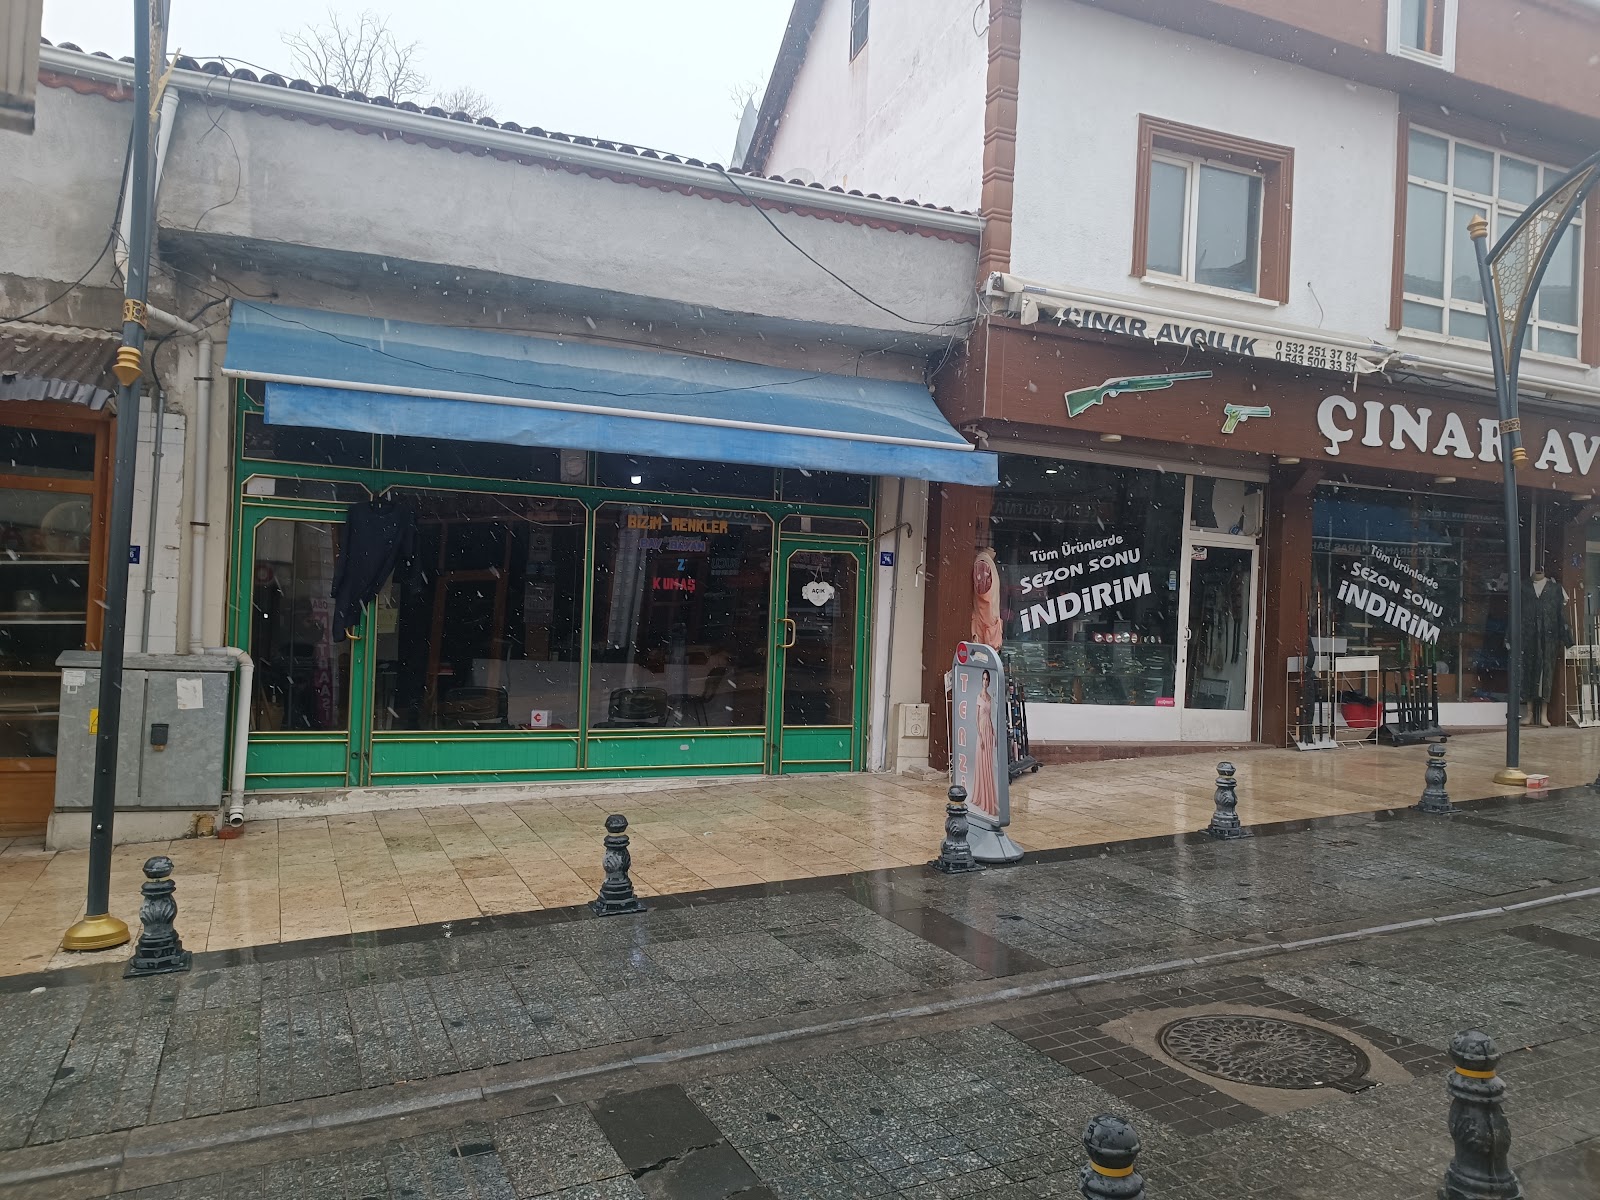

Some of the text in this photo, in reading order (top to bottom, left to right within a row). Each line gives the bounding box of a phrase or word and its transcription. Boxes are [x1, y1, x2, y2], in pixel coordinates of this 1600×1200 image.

[1275, 340, 1358, 362] 0 532 251 37 84
[1285, 353, 1304, 365] 543
[1307, 357, 1326, 369] 500
[1329, 359, 1342, 371] 33
[1316, 394, 1502, 463] ÇINAR
[671, 517, 728, 534] RENKLER
[640, 537, 663, 549] BAY
[668, 540, 706, 552] BAYAN
[1030, 534, 1124, 563] Tüm Ürünlerde
[1020, 548, 1141, 595] SEZON SONU
[1371, 544, 1439, 590] Tüm Ürünlerde
[1350, 562, 1444, 618] SEZON SONU
